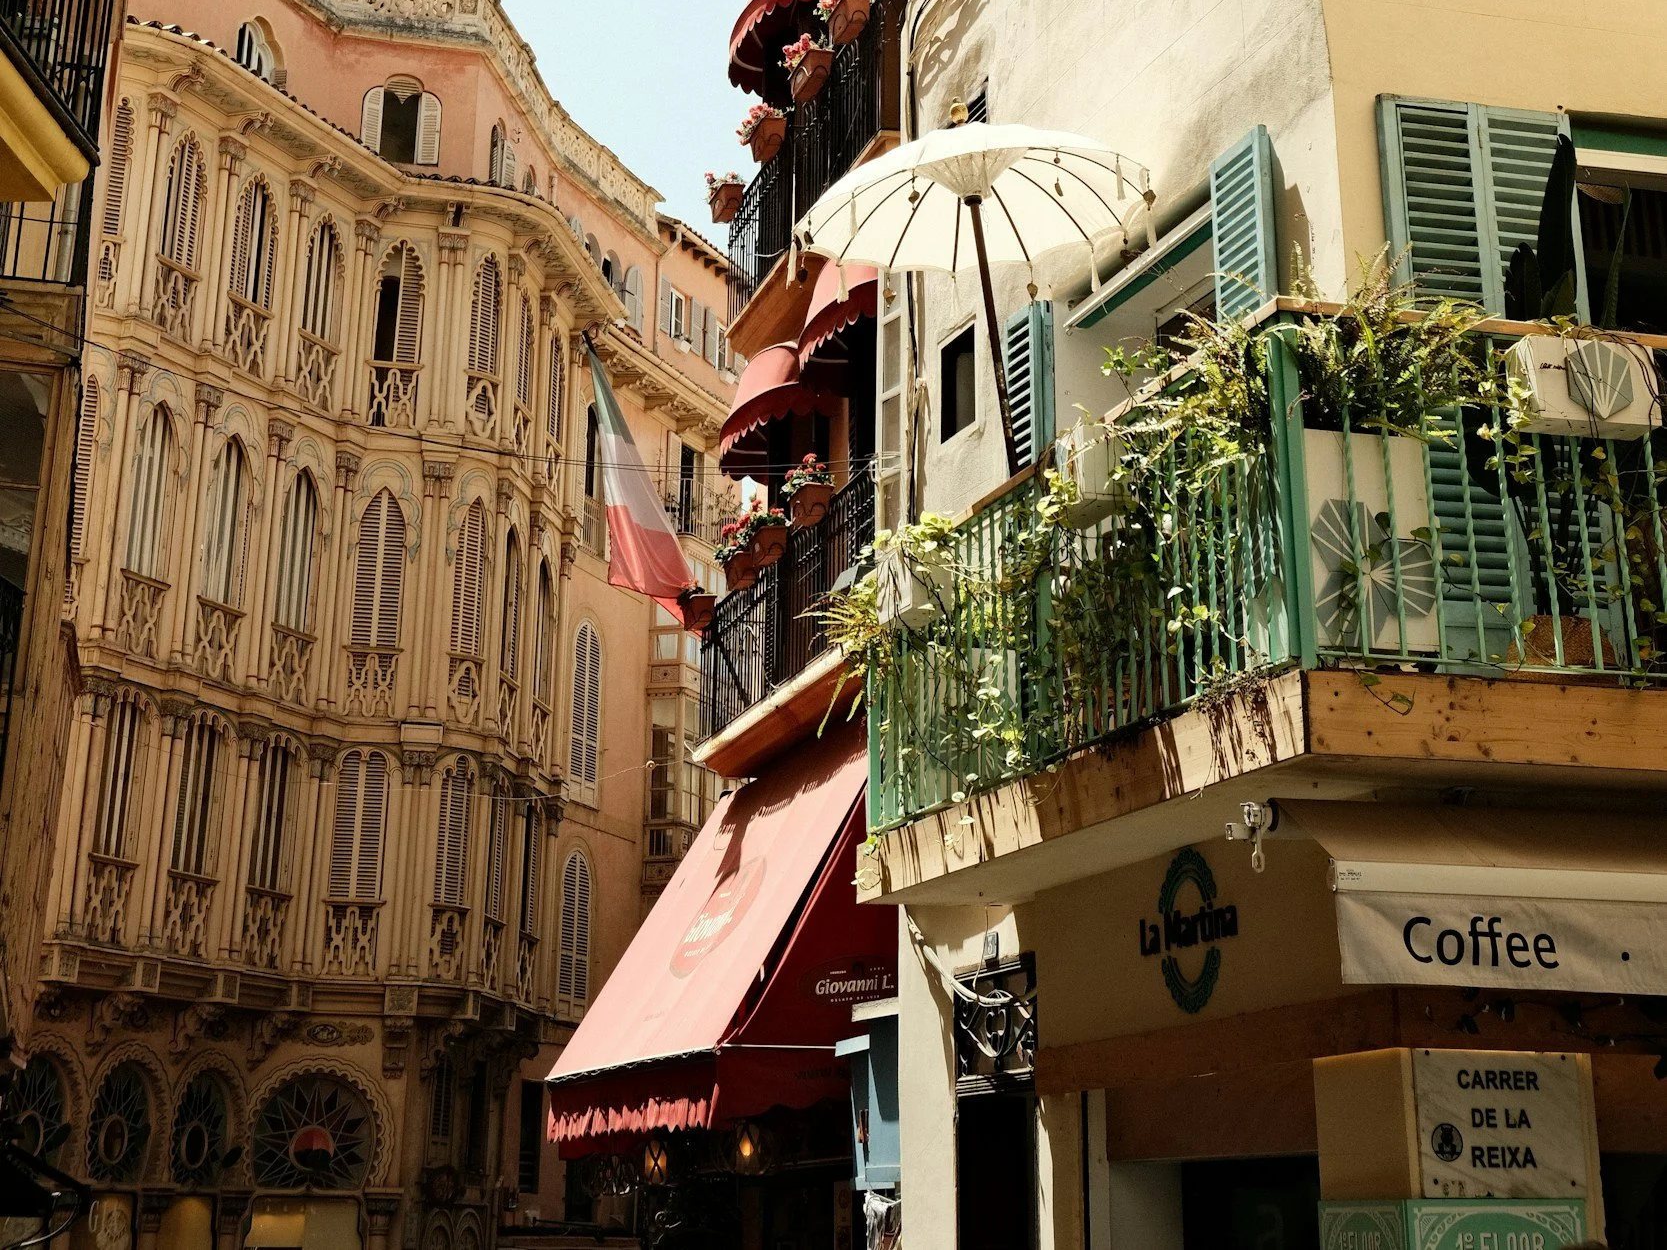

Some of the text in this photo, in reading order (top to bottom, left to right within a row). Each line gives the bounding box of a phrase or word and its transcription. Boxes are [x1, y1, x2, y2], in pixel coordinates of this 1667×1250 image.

[1140, 902, 1238, 956] La Martina
[1402, 916, 1560, 969] Coffee
[815, 974, 879, 996] Giovanni
[1457, 1069, 1540, 1091] CARRER
[1471, 1108, 1532, 1129] DE LA
[1471, 1146, 1538, 1169] REIXA
